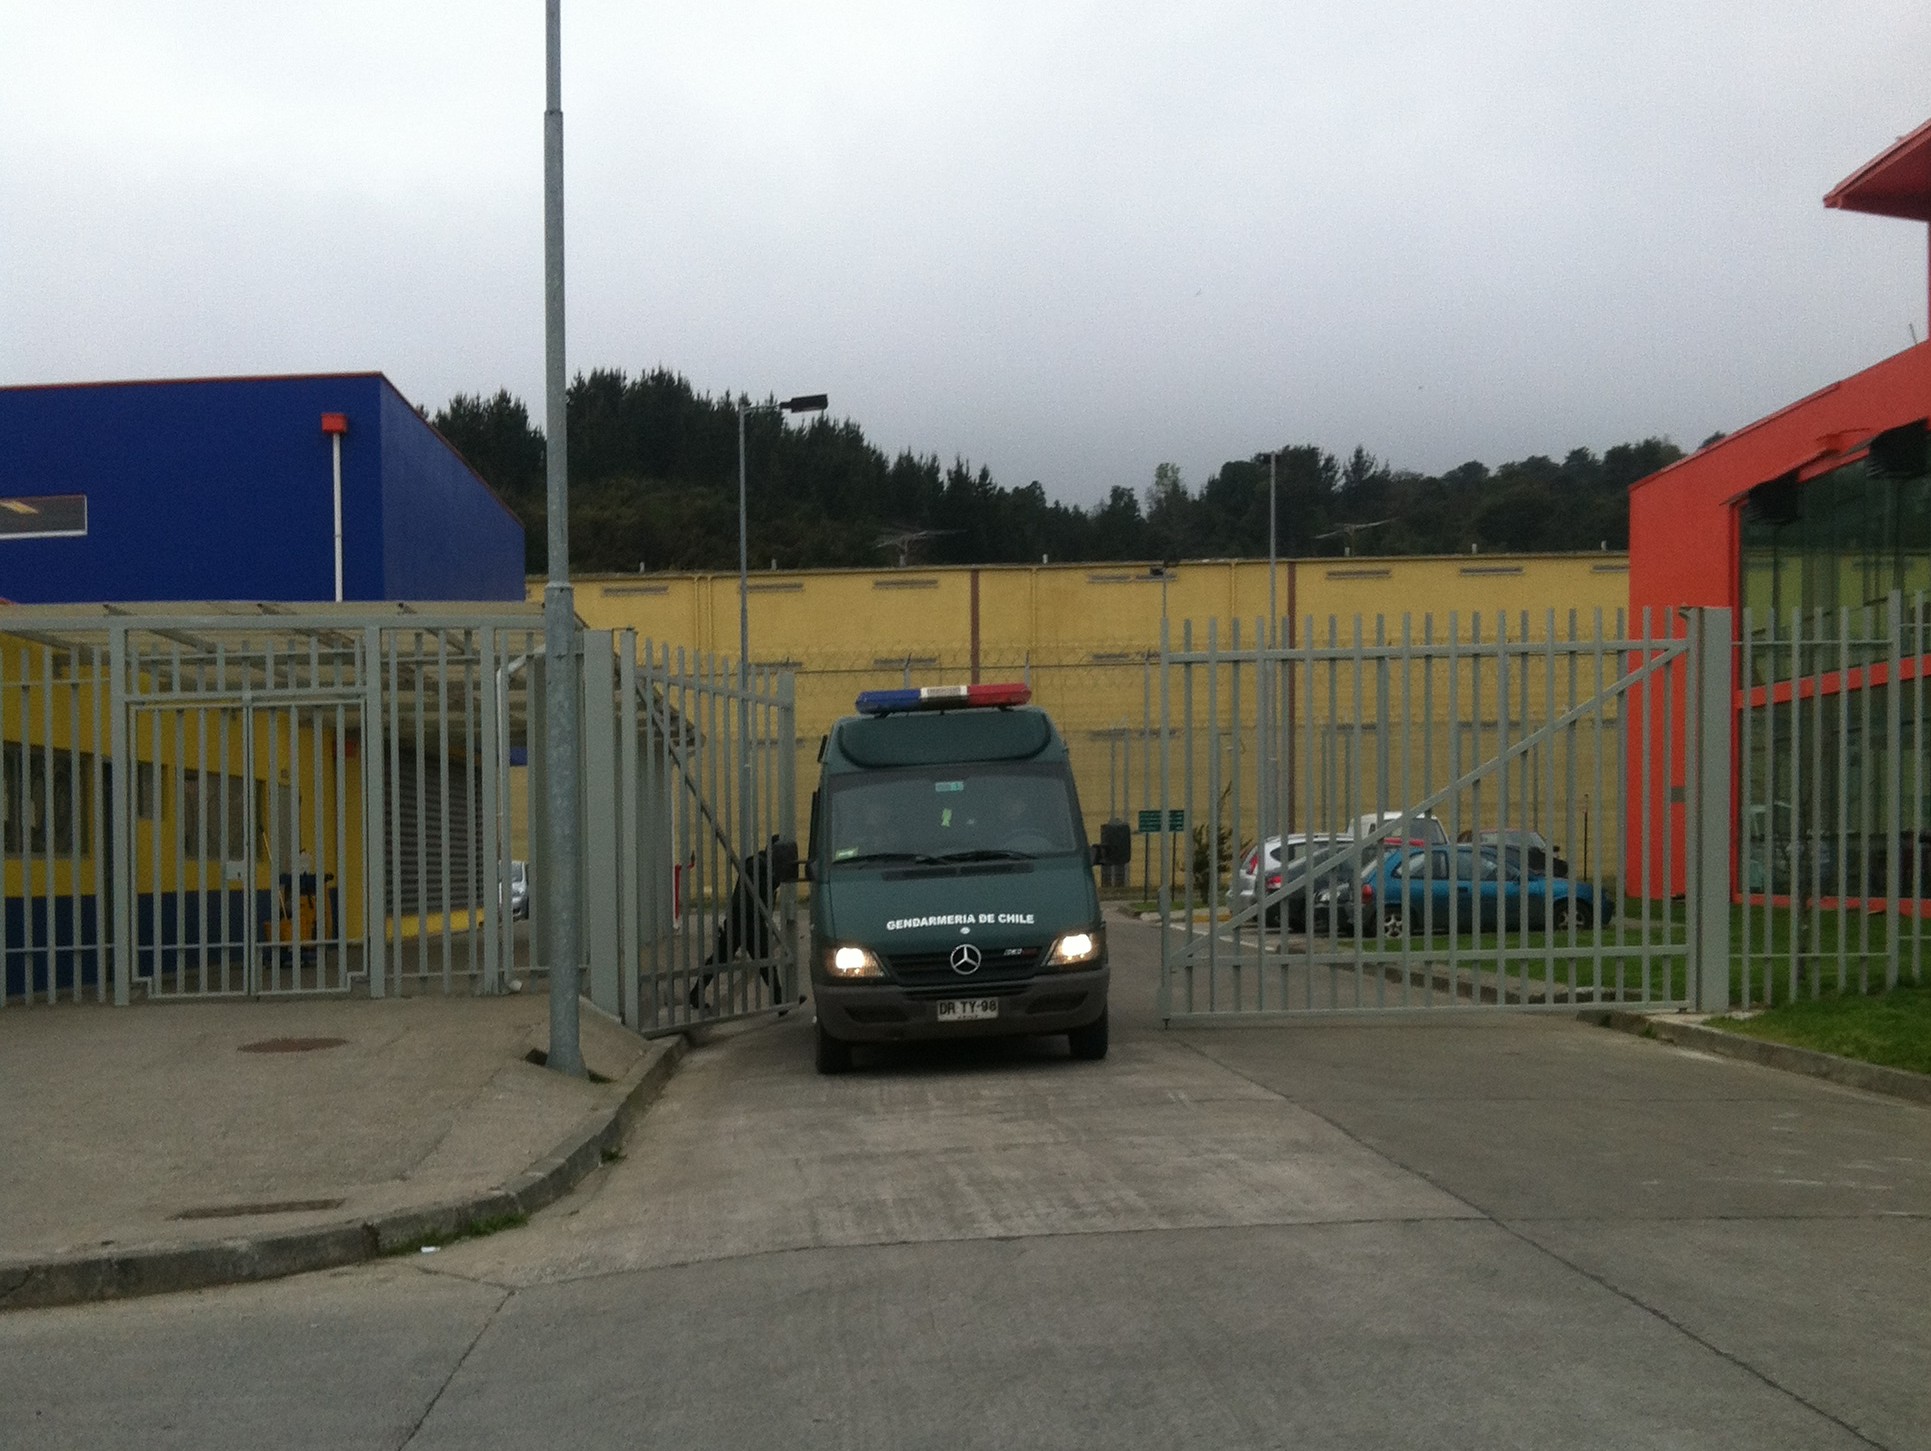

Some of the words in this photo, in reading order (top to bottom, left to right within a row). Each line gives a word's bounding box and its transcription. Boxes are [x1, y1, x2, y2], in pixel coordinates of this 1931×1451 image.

[886, 914, 976, 931] GENDARMERIA
[978, 913, 995, 924] DE
[997, 914, 1035, 925] CHILE
